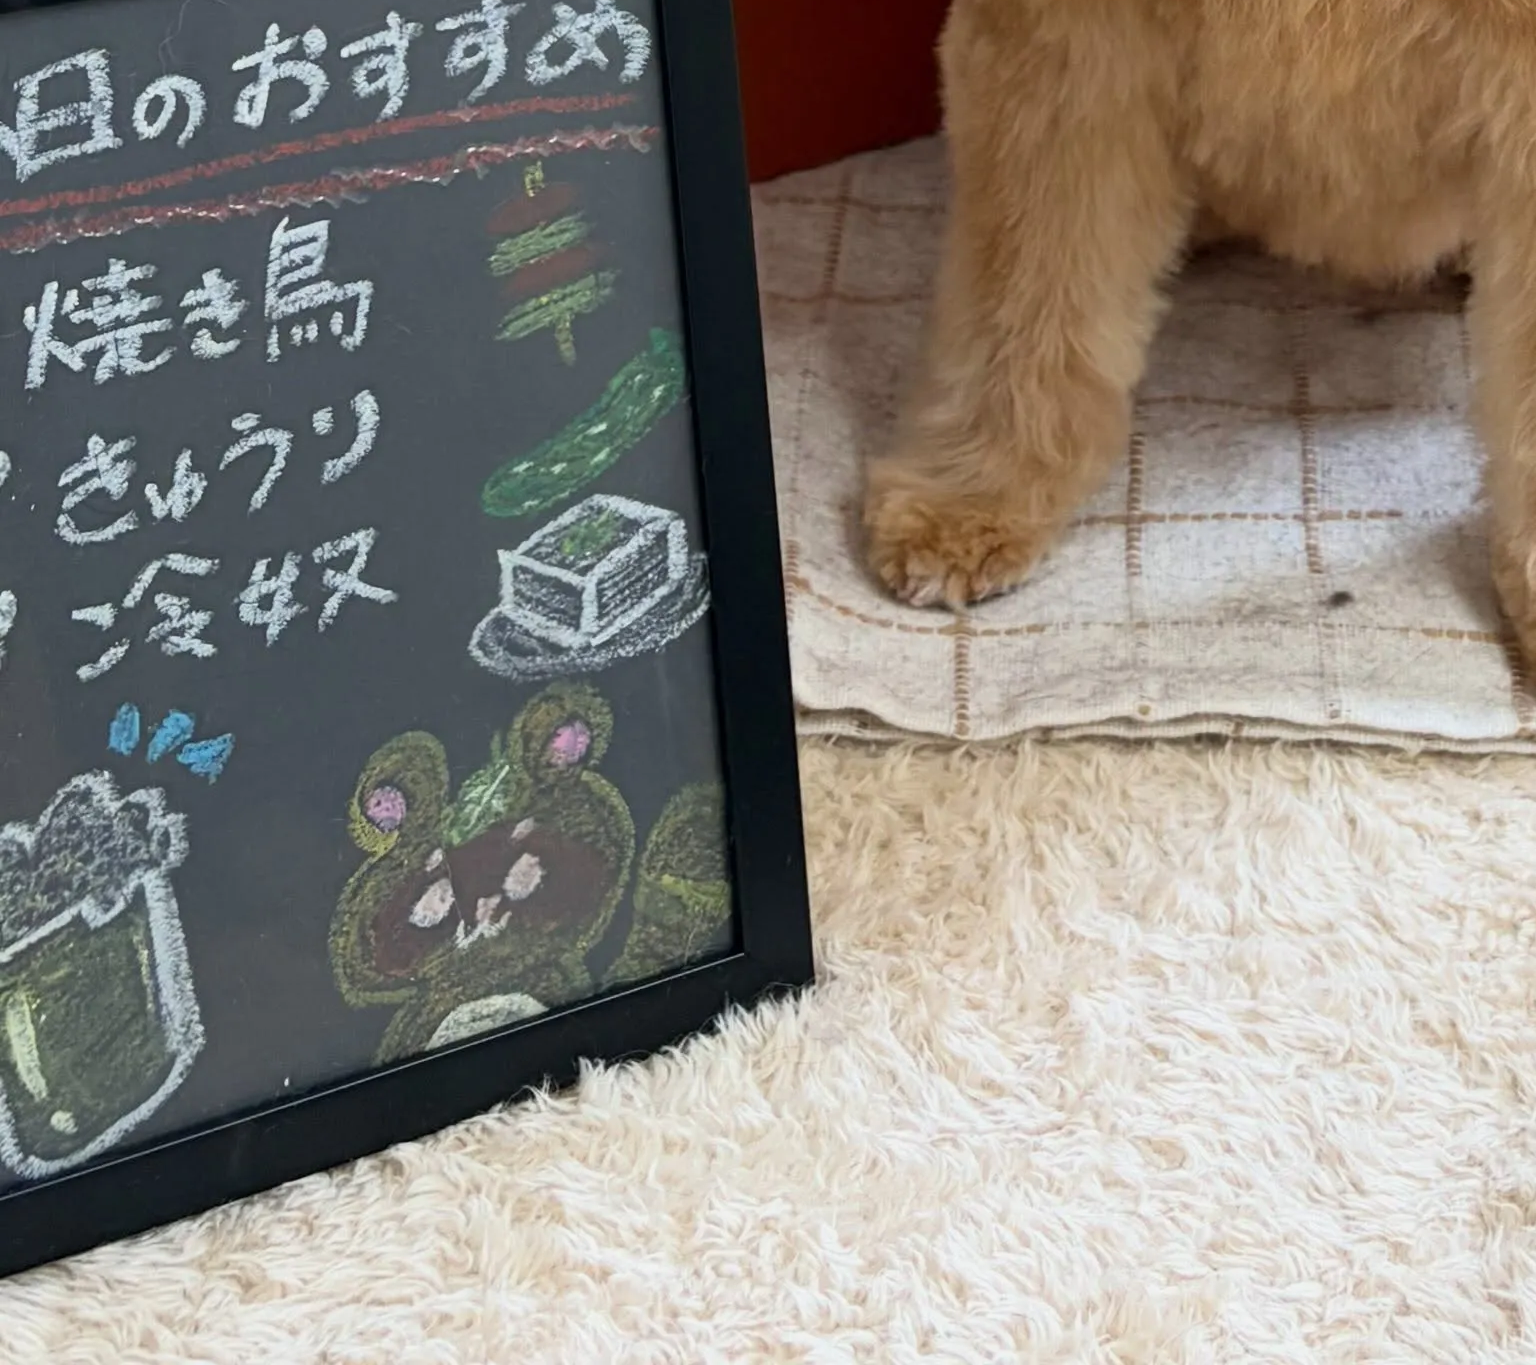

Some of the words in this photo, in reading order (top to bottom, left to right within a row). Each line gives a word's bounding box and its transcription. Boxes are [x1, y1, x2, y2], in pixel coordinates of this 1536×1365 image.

[22, 214, 376, 391] 焼き鳥
[54, 388, 382, 546] きゅうり
[70, 526, 400, 682] 冷奴
